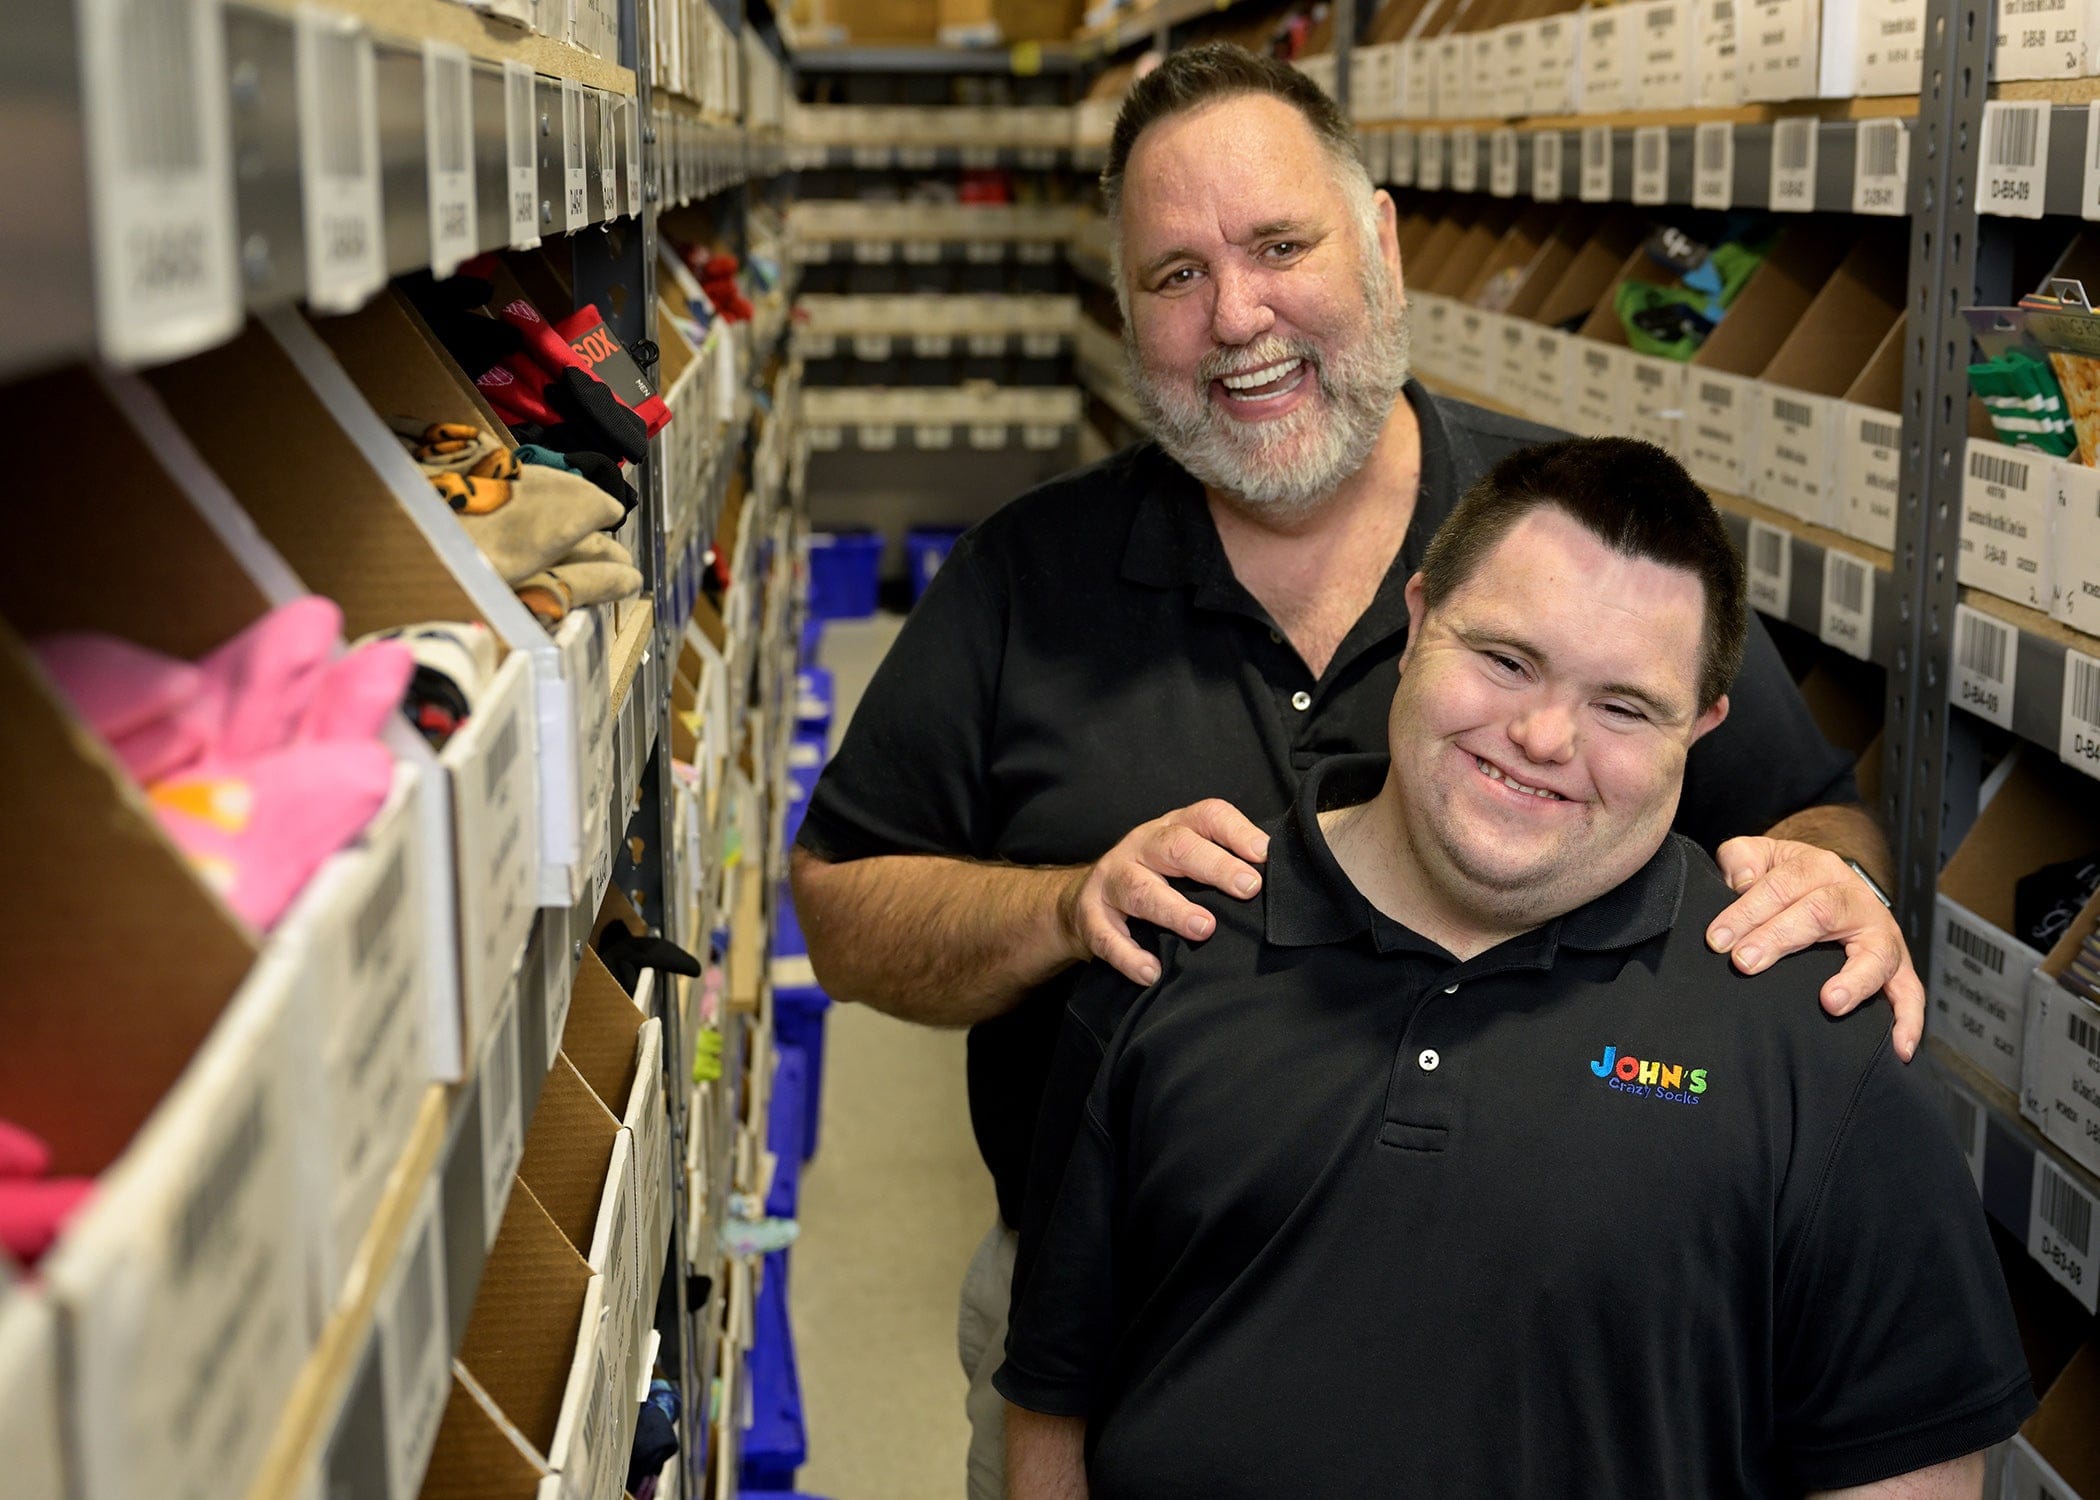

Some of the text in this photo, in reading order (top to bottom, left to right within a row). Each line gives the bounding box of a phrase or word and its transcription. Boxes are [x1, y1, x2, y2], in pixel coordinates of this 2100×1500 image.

[1991, 178, 2030, 201] D-B5-09
[571, 327, 620, 369] SOX
[634, 378, 651, 397] MEN
[1590, 1045, 1708, 1094] JOHN'S
[1608, 1077, 1700, 1105] Crazy Socks
